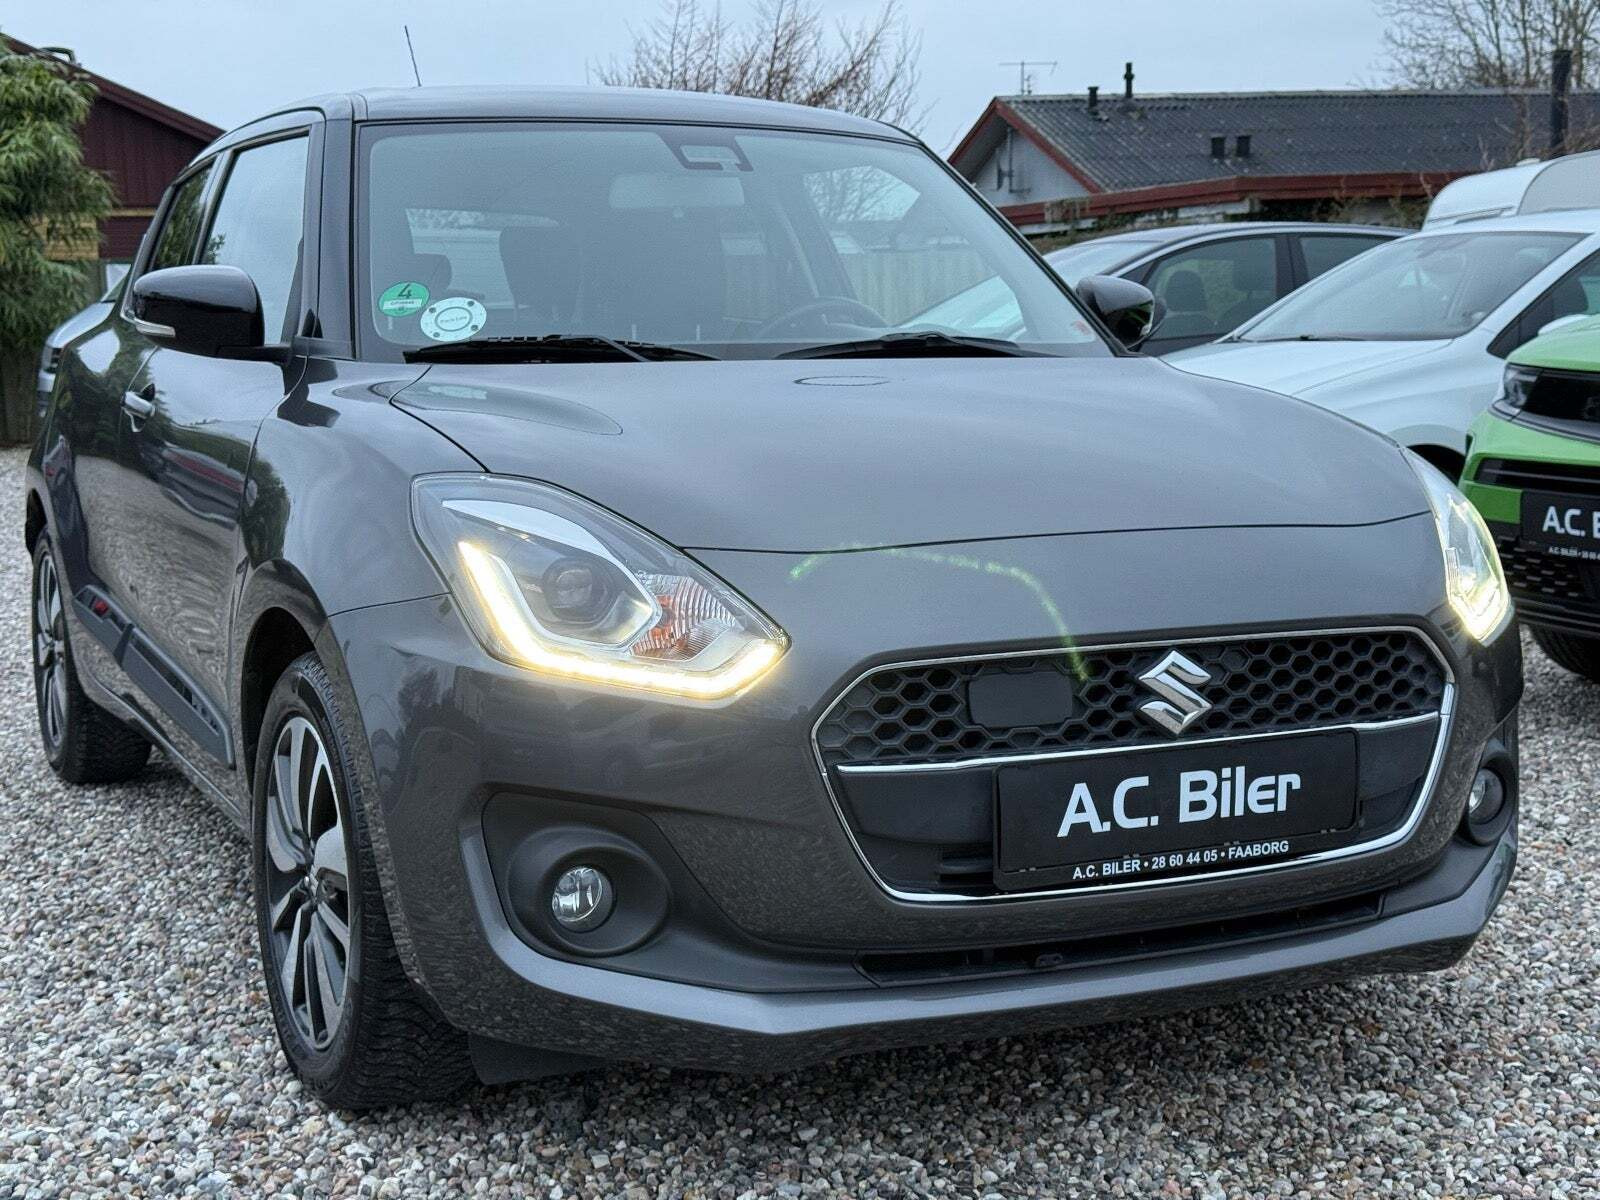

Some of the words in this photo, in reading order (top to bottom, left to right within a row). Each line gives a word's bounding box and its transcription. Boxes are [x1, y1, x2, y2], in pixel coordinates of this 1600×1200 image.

[398, 283, 412, 299] 4
[1542, 506, 1586, 537] A.C.
[1056, 775, 1160, 838] A.C.
[1178, 766, 1302, 823] Biler
[1072, 865, 1099, 880] A.C.
[1102, 860, 1141, 876] BILER
[1151, 857, 1166, 870] 28
[1169, 854, 1184, 868] 60
[1186, 851, 1201, 865] 44
[1203, 849, 1218, 863] 05
[1228, 840, 1290, 860] FAABORG
